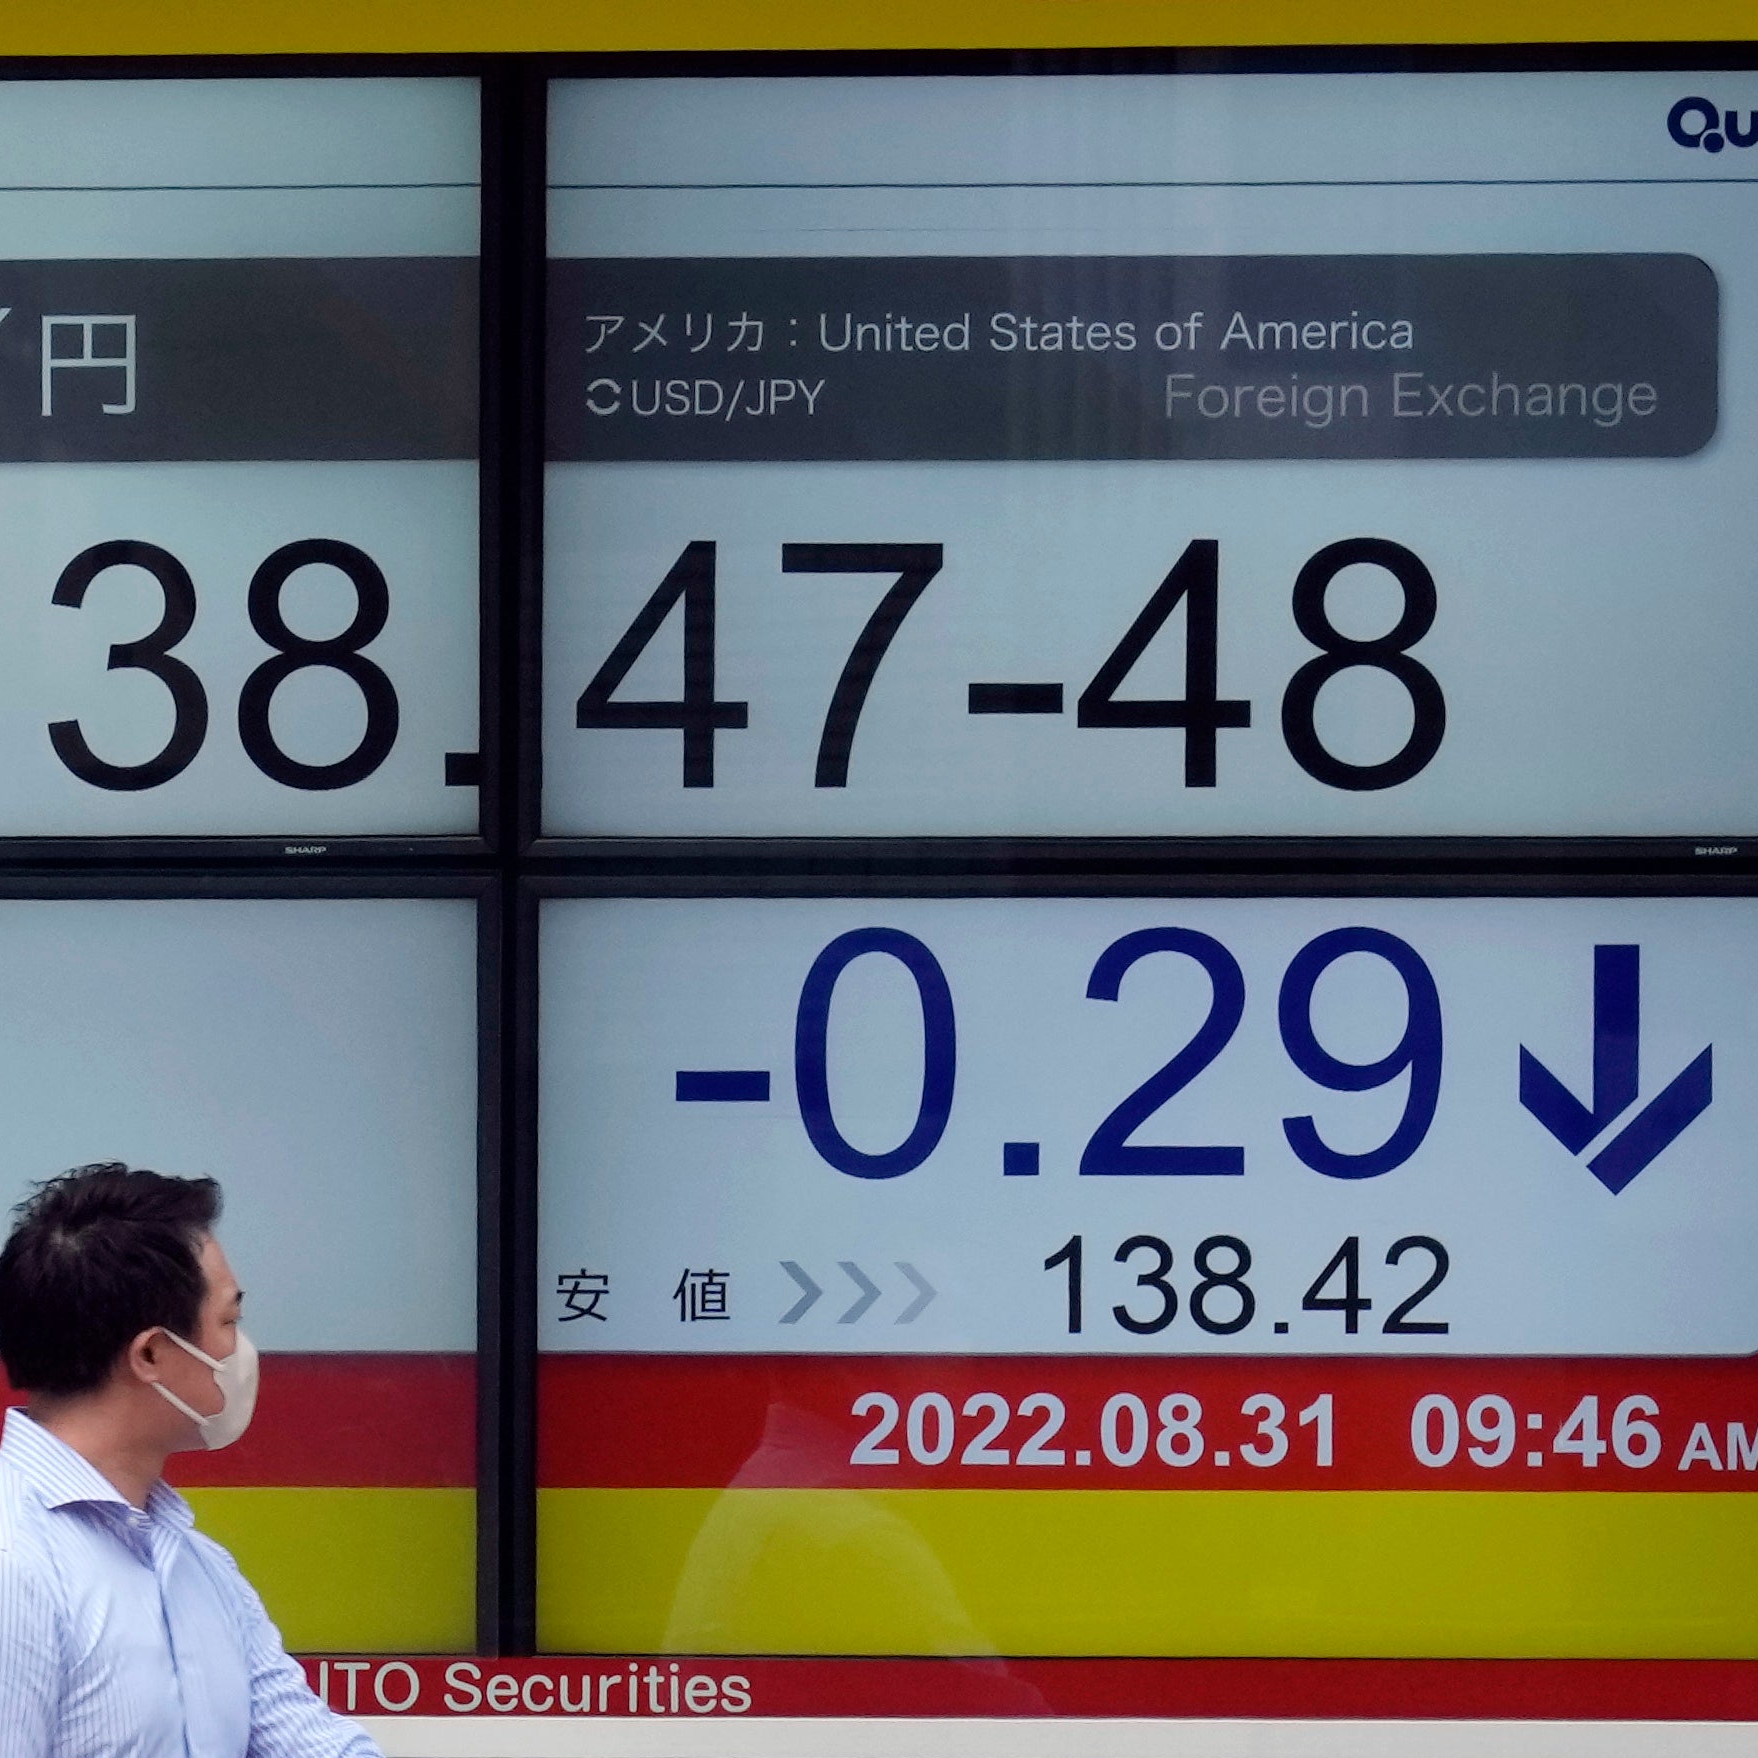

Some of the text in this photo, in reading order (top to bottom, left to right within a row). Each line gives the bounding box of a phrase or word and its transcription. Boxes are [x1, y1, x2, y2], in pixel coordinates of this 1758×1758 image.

[819, 312, 970, 352] United
[990, 312, 1137, 352] States
[1155, 311, 1204, 351] of
[1219, 310, 1413, 350] America
[632, 378, 826, 422] USD/JPY
[1166, 371, 1658, 428] Foreign Exchange
[675, 926, 1444, 1180] -0.29
[1044, 1234, 1451, 1336] 138.42
[849, 1391, 1334, 1469] 2022.08.31
[1410, 1393, 1663, 1469] 09:46
[319, 1660, 752, 1714] ITO Securities
